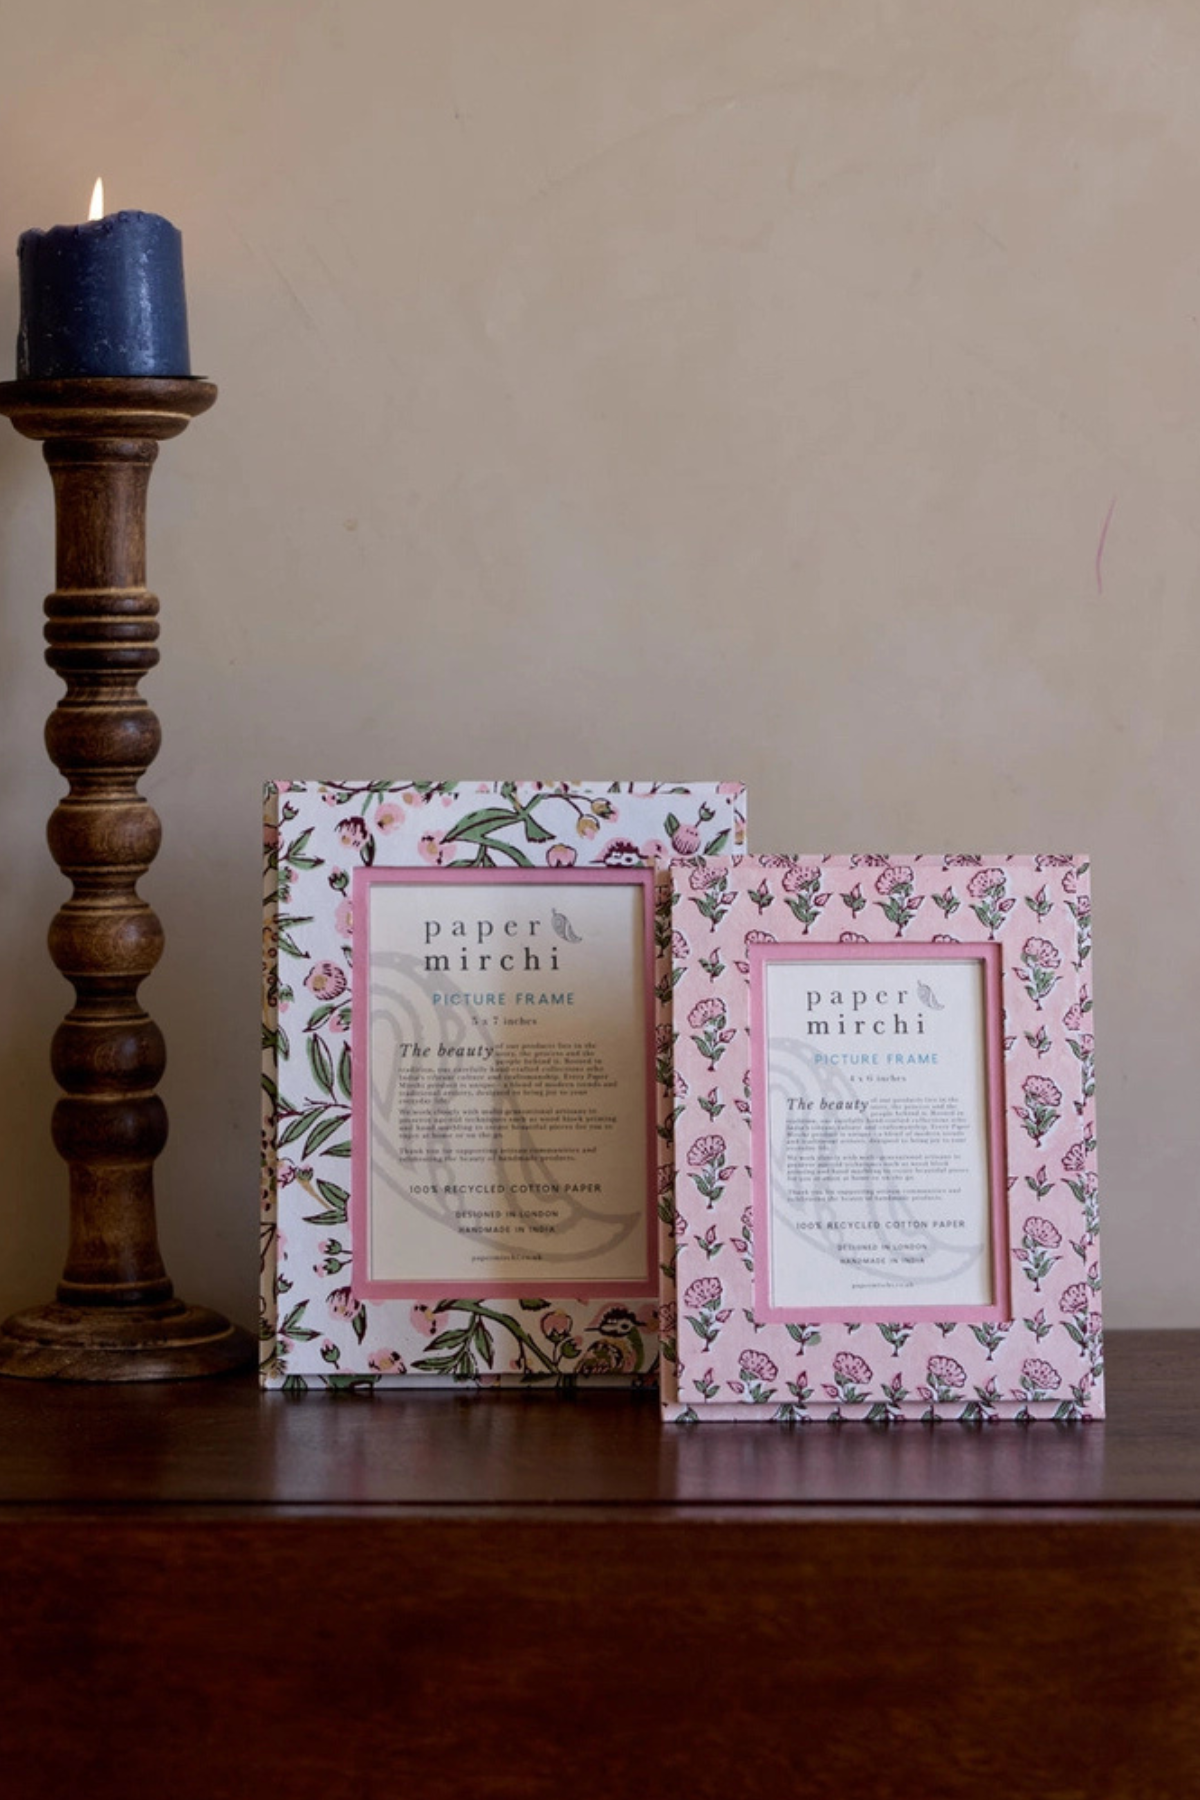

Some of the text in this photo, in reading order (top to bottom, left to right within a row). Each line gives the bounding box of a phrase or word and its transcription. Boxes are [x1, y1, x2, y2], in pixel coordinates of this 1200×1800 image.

[424, 919, 541, 945] paper
[424, 946, 560, 972] mirchi
[432, 992, 575, 1006] PICTURE FRAME
[806, 989, 909, 1011] paper
[471, 1016, 479, 1026] 5
[492, 1016, 499, 1026] 7
[503, 1016, 538, 1026] inches
[806, 1013, 925, 1035] mirchi
[399, 1042, 431, 1058] The
[437, 1042, 495, 1061] beauty
[813, 1052, 939, 1066] PICTURE FRAME
[787, 1097, 814, 1110] The
[819, 1097, 869, 1113] beauty
[409, 1183, 602, 1195] 100% RECYCLED COTTON PAPER
[455, 1210, 559, 1219] DESIGNED IN LONDON
[458, 1225, 556, 1234] HANDMADE IN INDIA
[796, 1219, 966, 1231] 100% RECYCLED COTTON PAPER
[881, 1243, 891, 1251] IN
[840, 1257, 886, 1265] HANDMADE
[901, 1256, 926, 1264] INDIA
